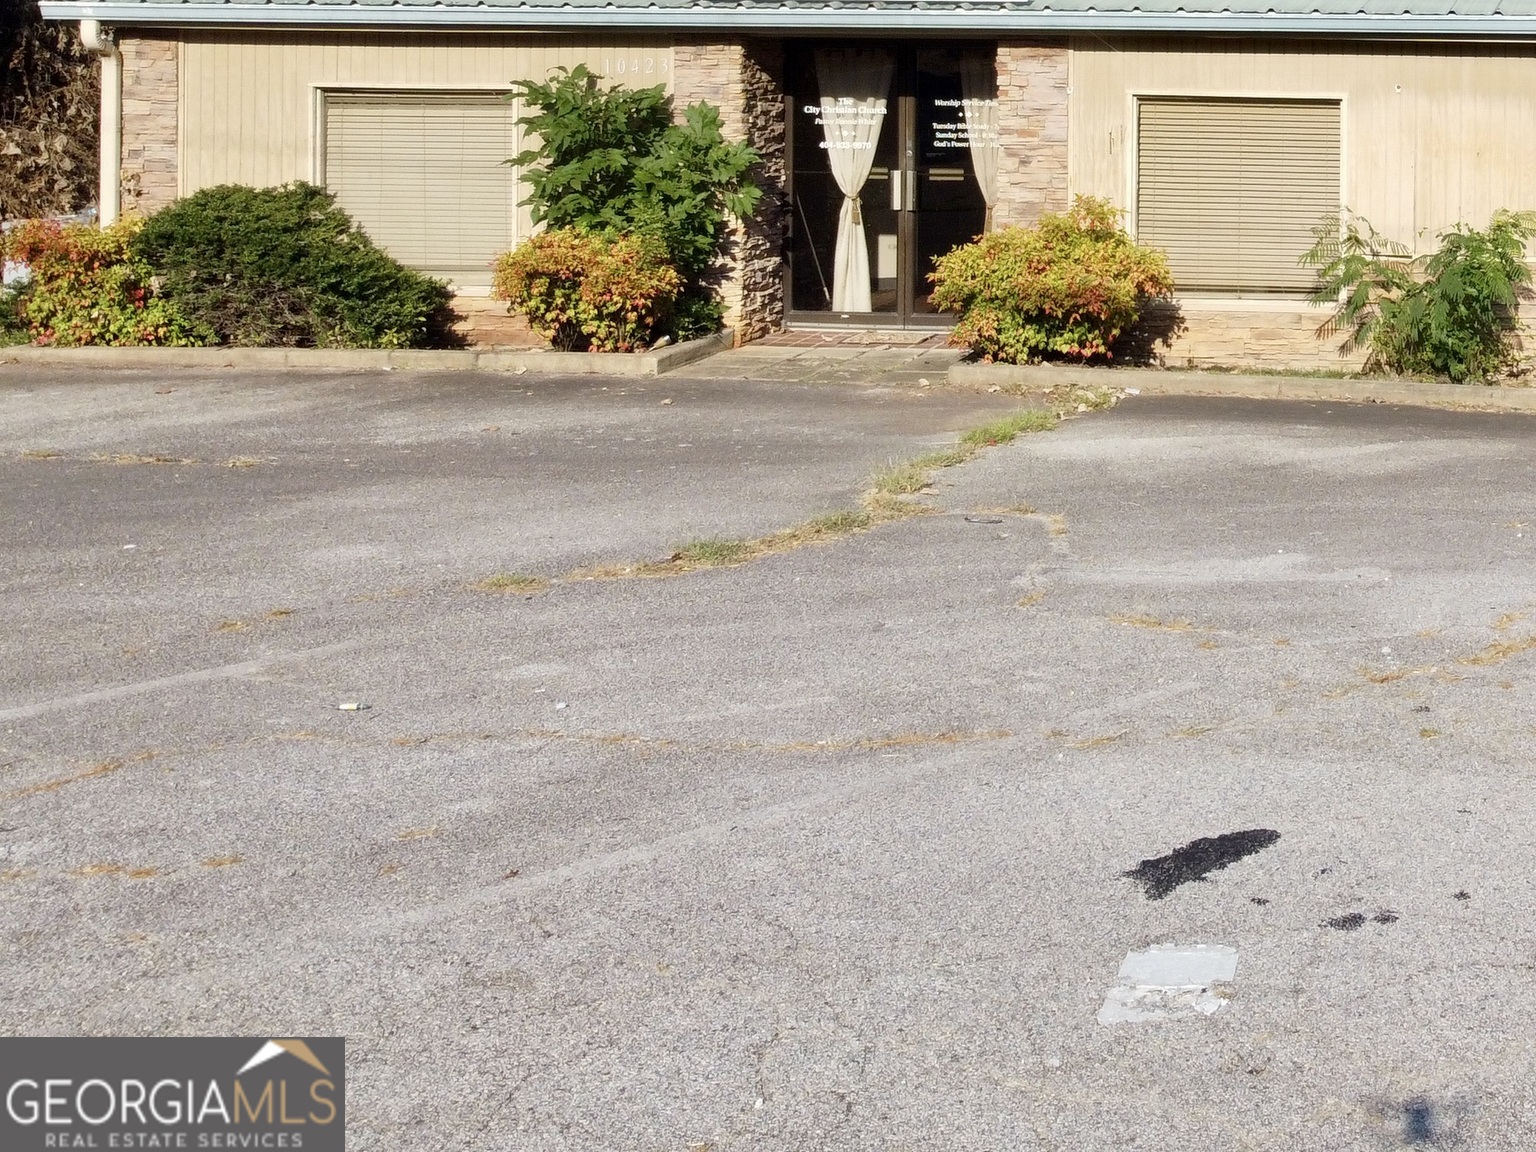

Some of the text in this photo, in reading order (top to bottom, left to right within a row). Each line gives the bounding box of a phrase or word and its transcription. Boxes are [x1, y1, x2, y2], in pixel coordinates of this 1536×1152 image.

[605, 57, 669, 75] 10423
[838, 97, 854, 106] The
[934, 99, 960, 108] Worship
[803, 105, 888, 115] City Christian Church
[932, 122, 957, 131] Tuesday
[935, 131, 958, 140] Sunday
[957, 131, 978, 139] School
[933, 140, 951, 148] God's
[951, 140, 969, 148] Power
